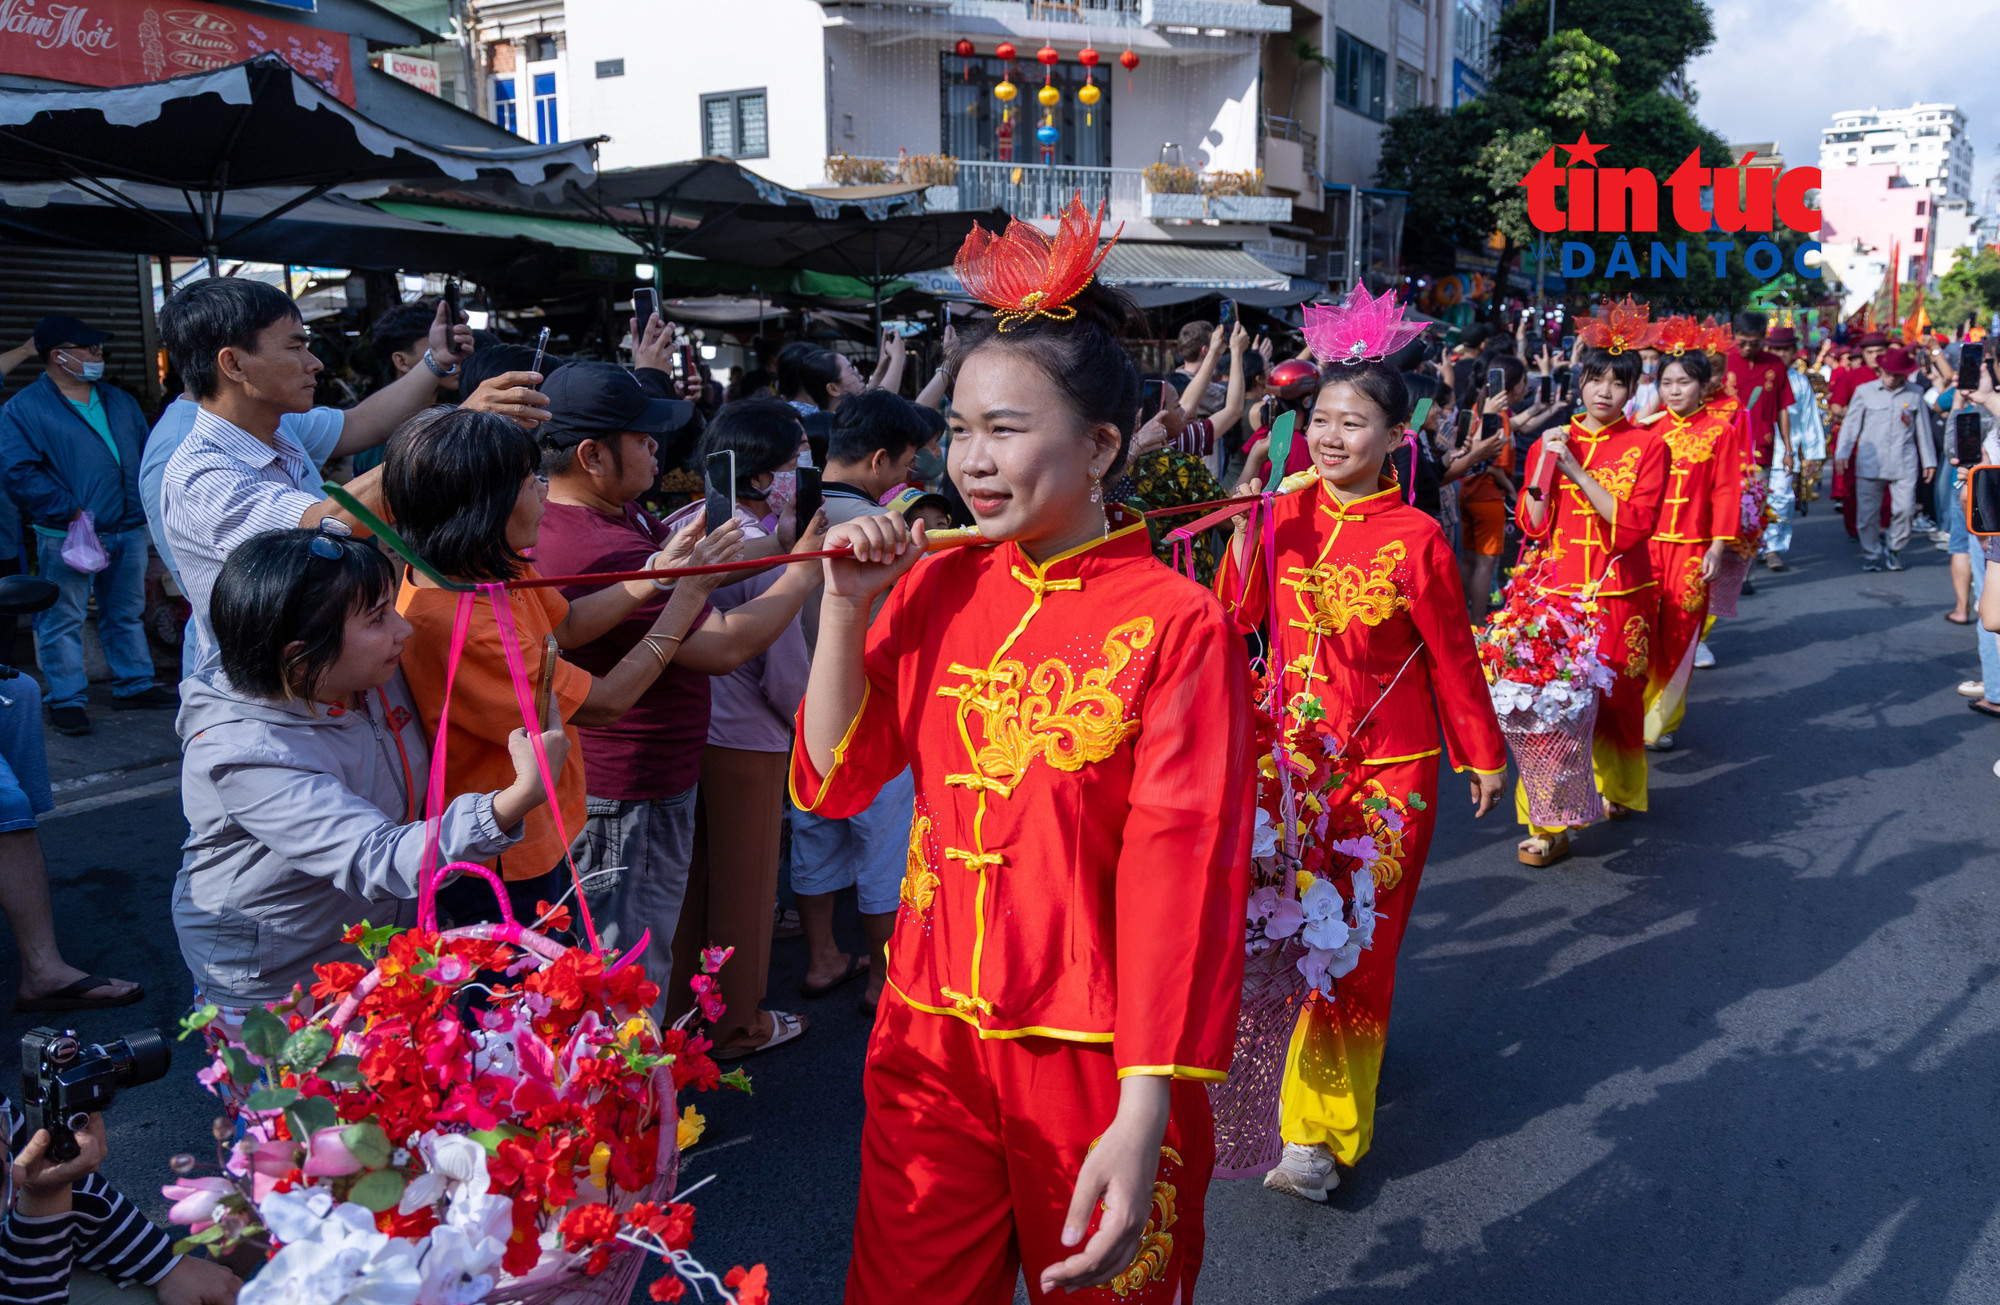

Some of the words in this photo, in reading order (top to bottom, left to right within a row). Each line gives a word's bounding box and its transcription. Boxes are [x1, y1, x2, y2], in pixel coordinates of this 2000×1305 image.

[36, 4, 118, 56] Mới
[168, 13, 228, 31] An
[176, 30, 233, 51] Khang
[420, 64, 437, 80] GÀ
